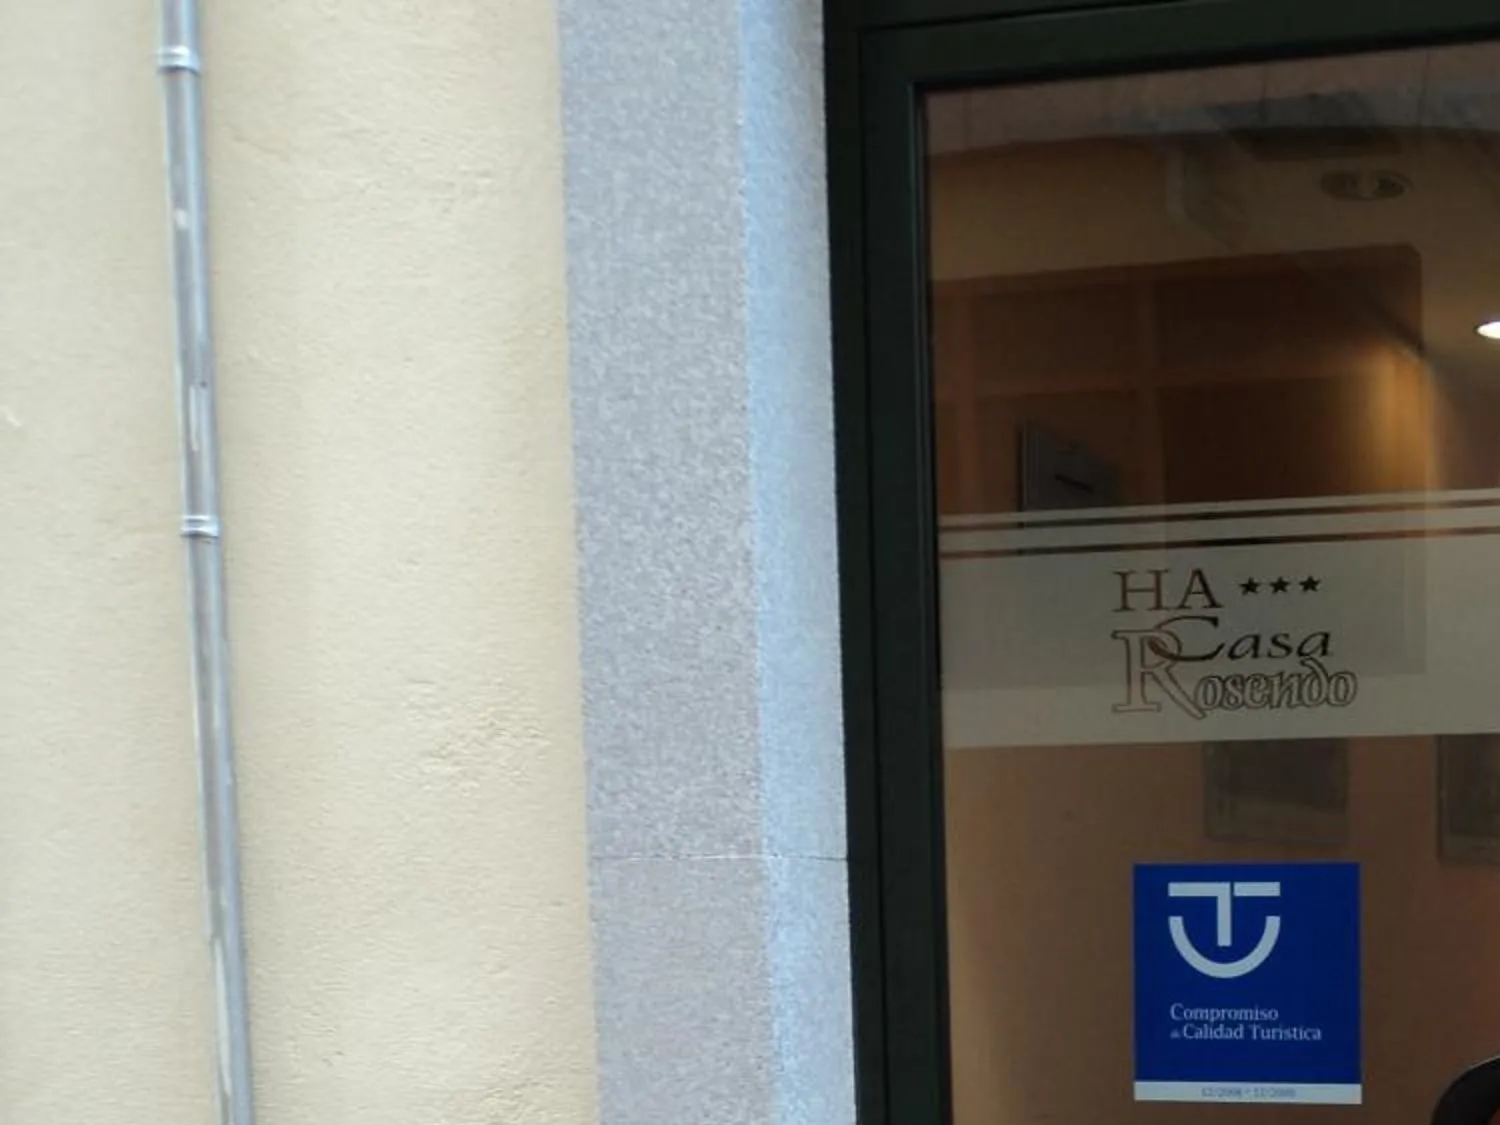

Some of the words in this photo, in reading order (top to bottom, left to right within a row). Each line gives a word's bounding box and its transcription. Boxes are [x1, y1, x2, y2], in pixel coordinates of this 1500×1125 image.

[1112, 568, 1224, 612] HA
[1150, 614, 1334, 662] Casa
[1110, 629, 1359, 720] Rosendo
[1170, 1002, 1279, 1023] Compromiso
[1183, 1023, 1245, 1040] Calidad
